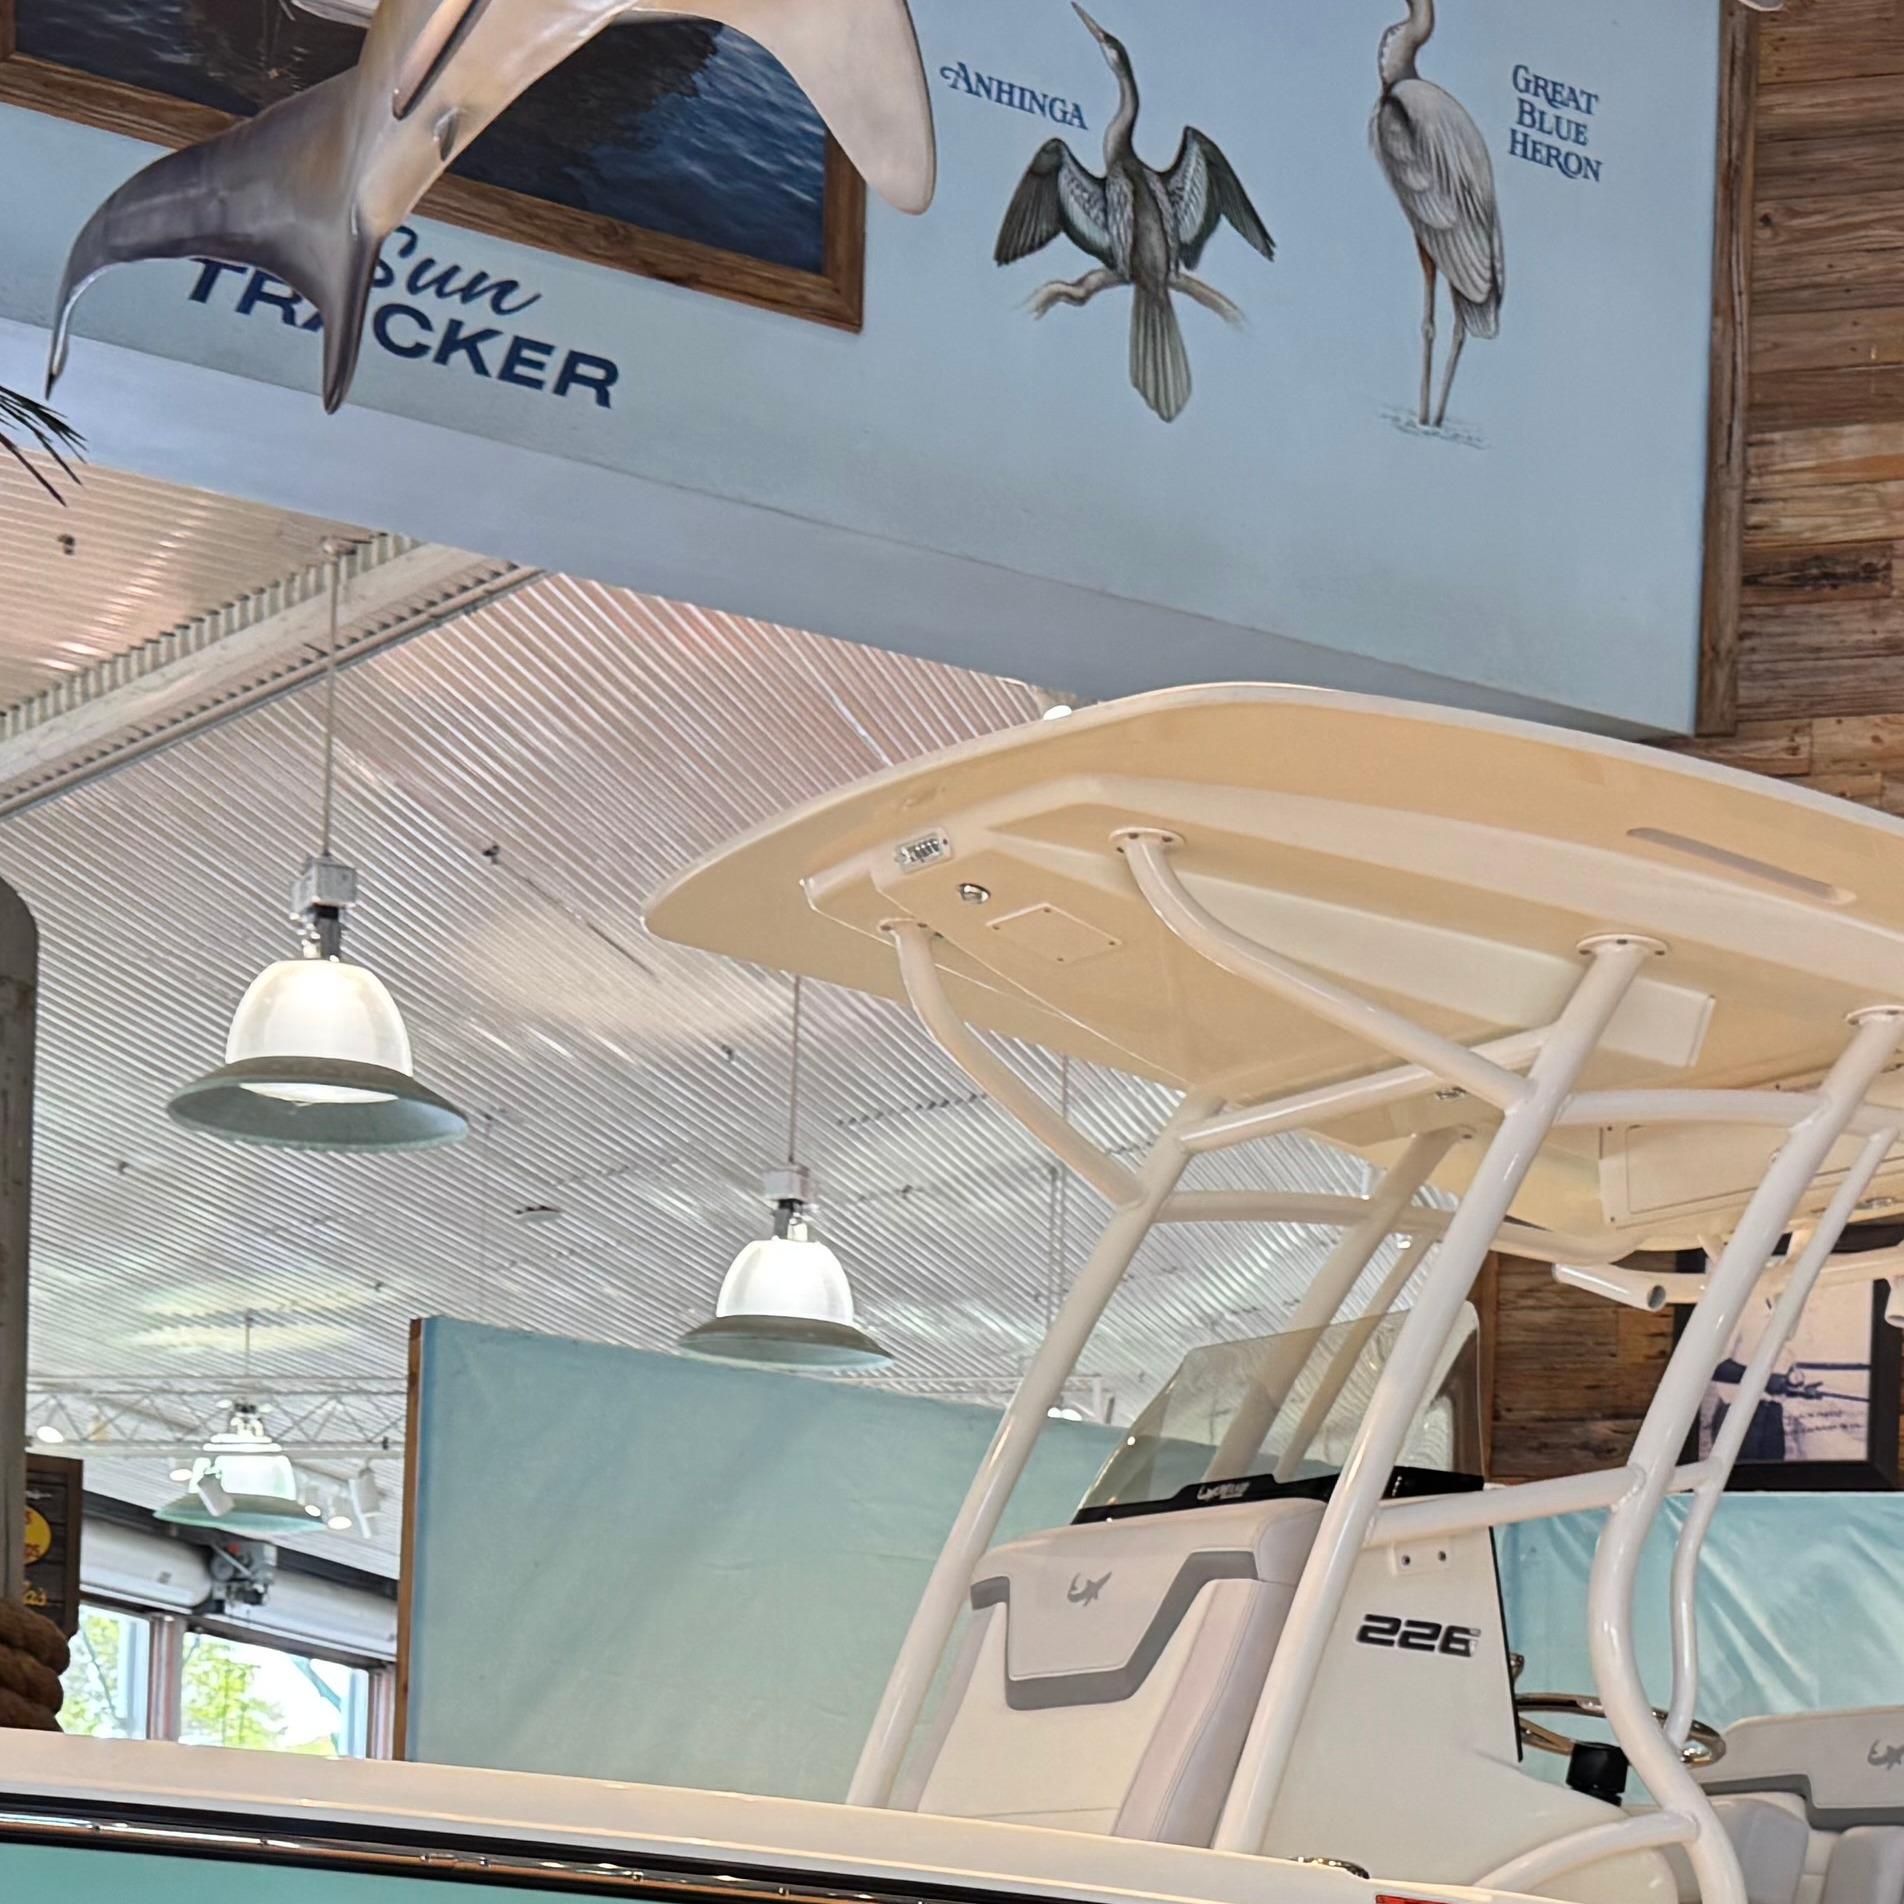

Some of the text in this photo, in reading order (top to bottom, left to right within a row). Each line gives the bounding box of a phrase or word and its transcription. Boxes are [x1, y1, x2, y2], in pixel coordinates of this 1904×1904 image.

[939, 61, 1088, 130] ANHINGA
[1512, 64, 1599, 115] GREAT
[1516, 97, 1588, 146] BLUE
[1508, 128, 1602, 182] HERON
[189, 258, 620, 408] TRCKER
[1356, 1613, 1481, 1658] 226
